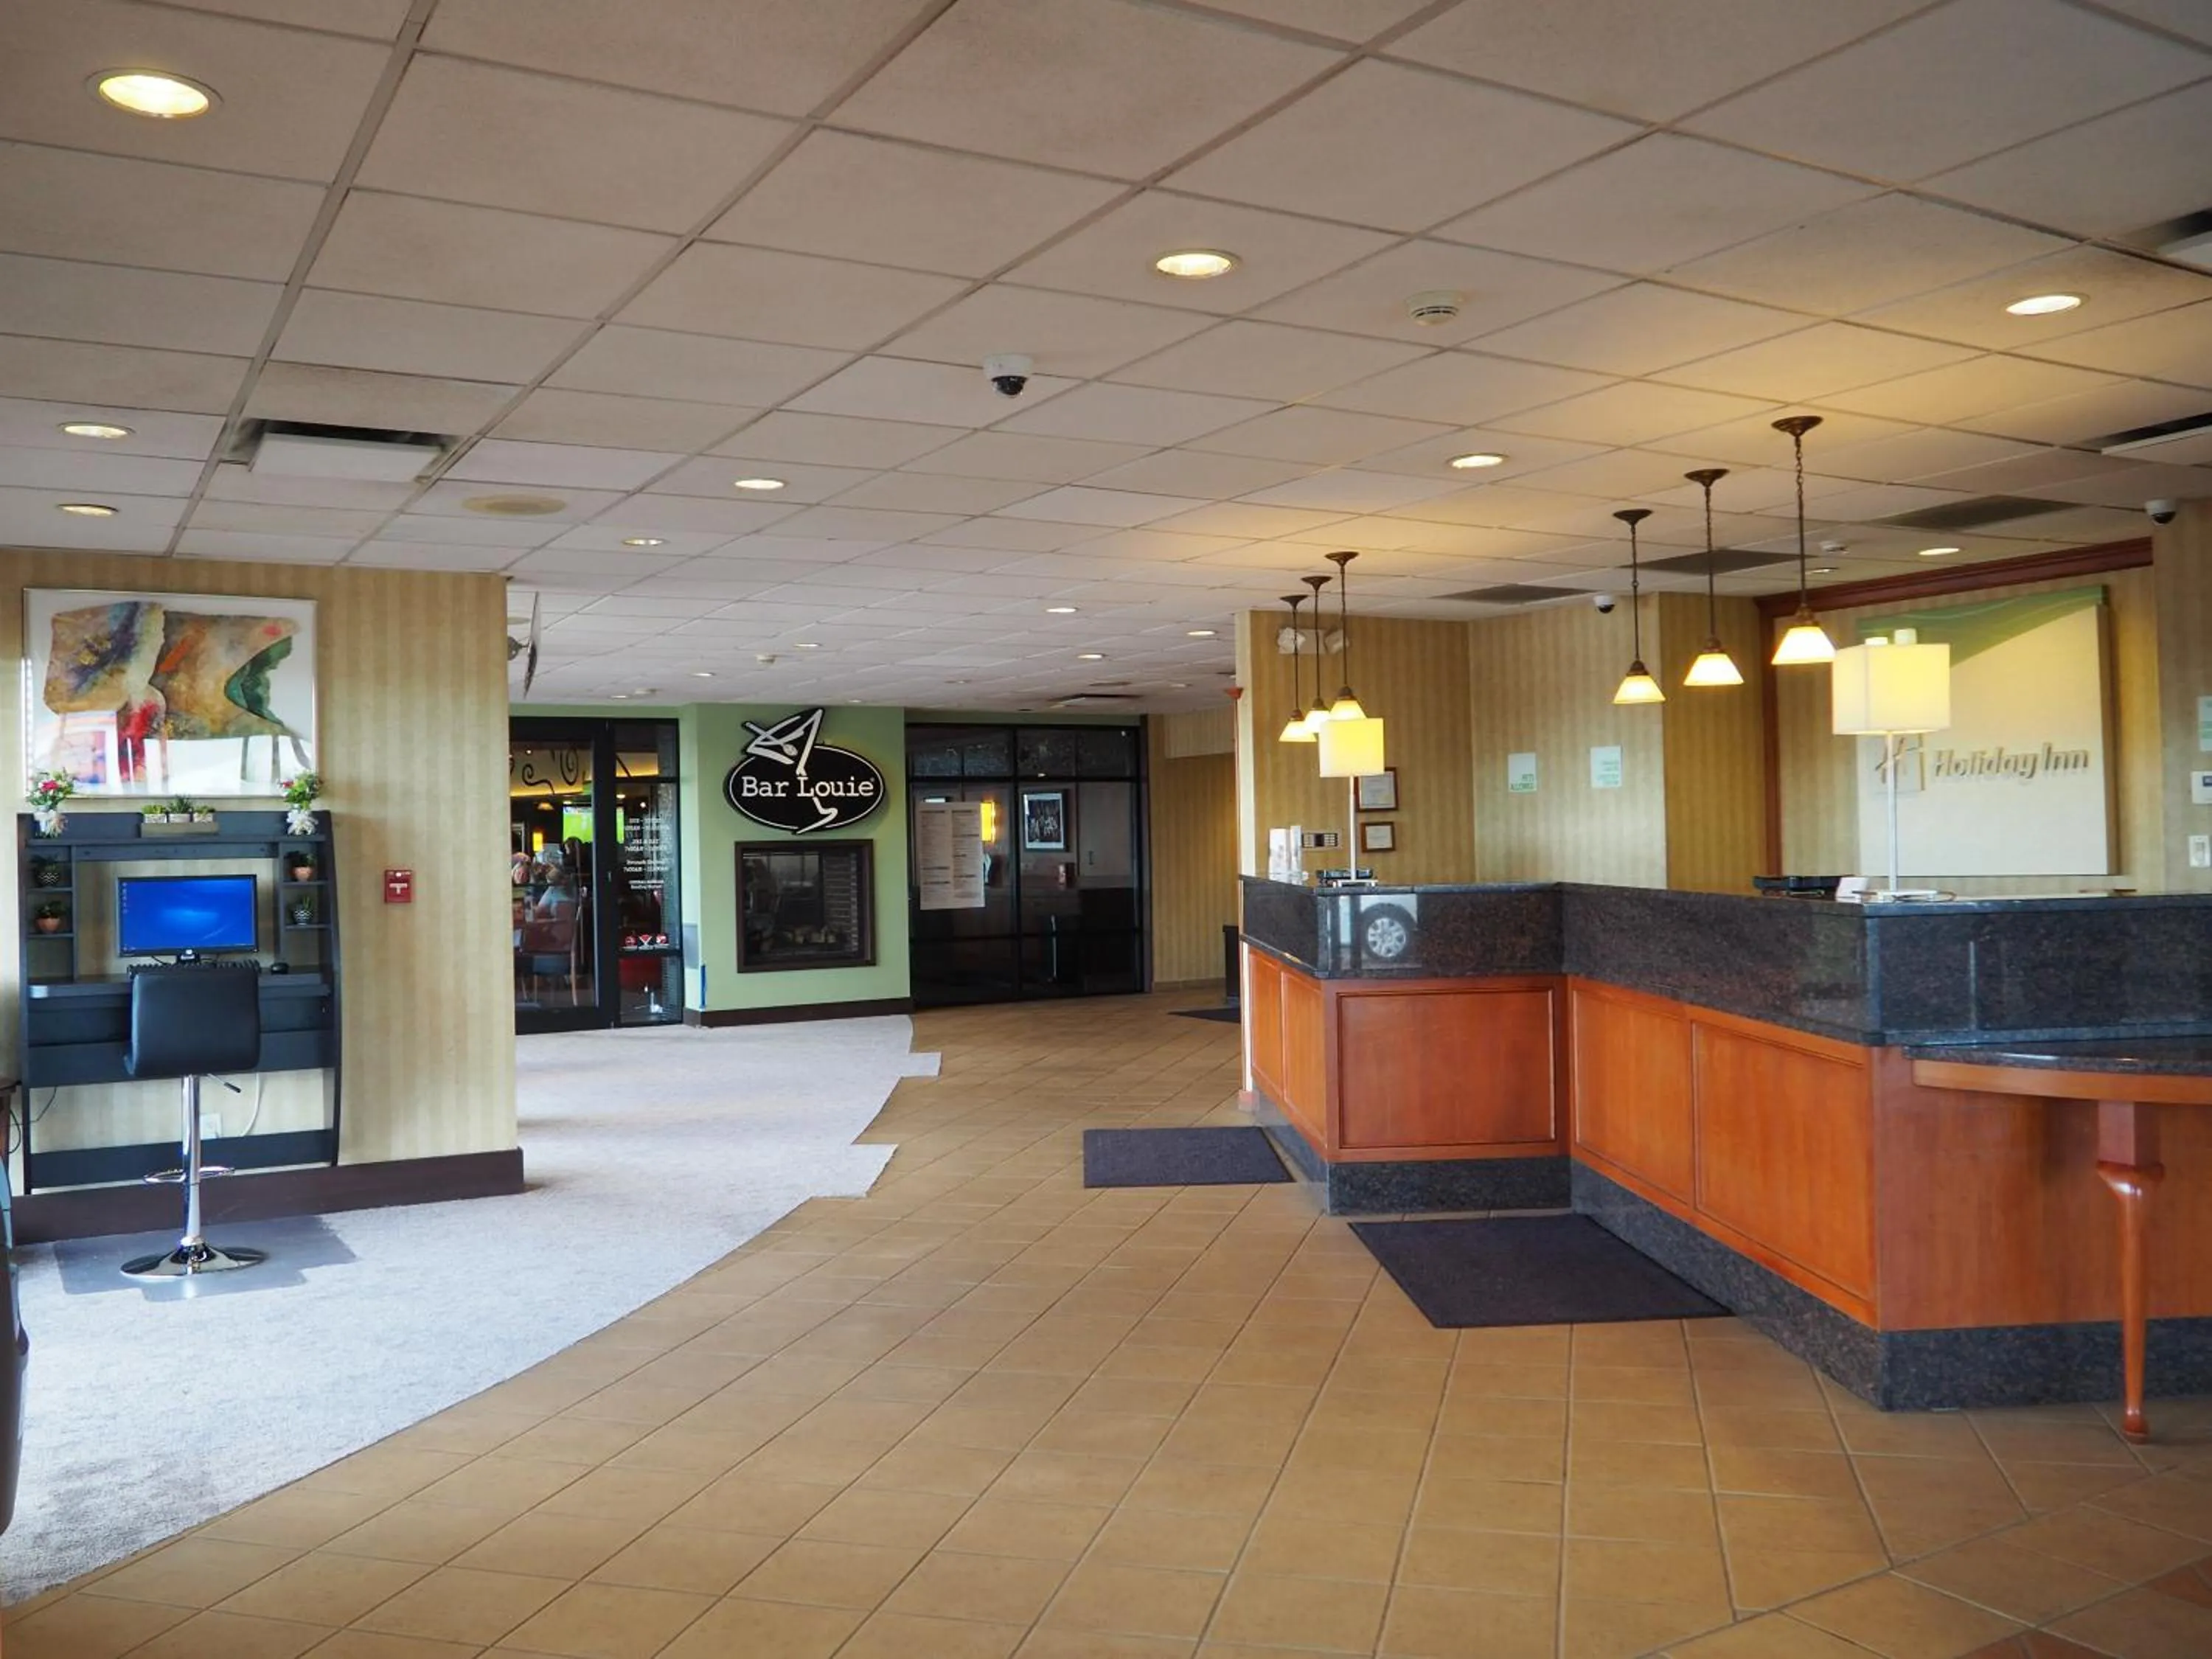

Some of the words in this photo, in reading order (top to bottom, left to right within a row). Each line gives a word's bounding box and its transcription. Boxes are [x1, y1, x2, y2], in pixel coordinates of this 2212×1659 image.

[1935, 746, 2038, 779] Holiday
[2042, 742, 2090, 771] Inn
[742, 776, 789, 797] Bar
[796, 776, 874, 797] Louie
